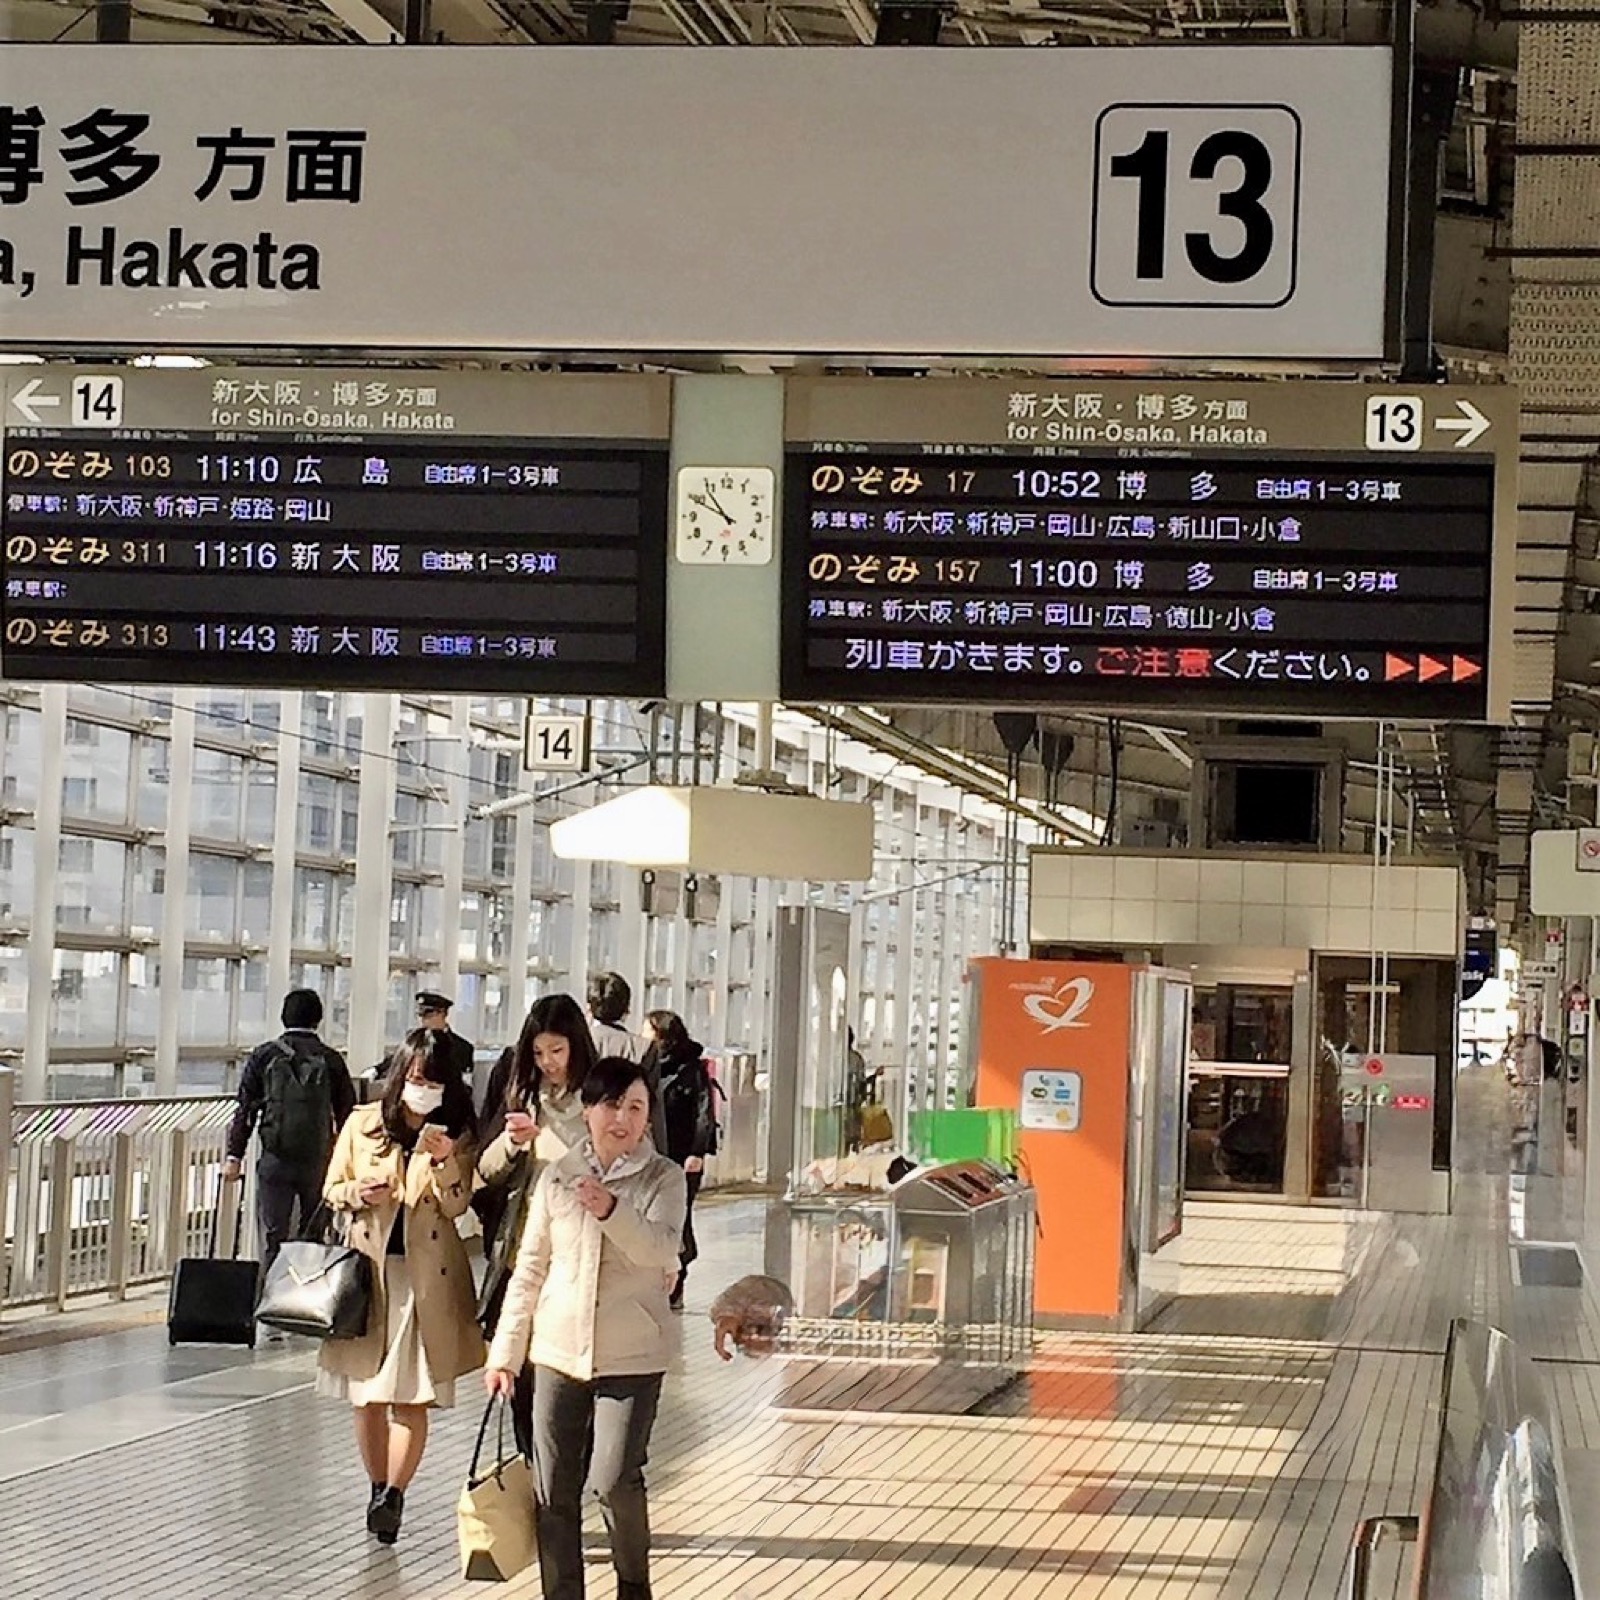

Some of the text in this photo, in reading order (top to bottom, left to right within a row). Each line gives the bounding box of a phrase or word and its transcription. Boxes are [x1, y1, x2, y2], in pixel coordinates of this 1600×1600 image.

[194, 127, 367, 204] 方面
[1110, 130, 1274, 284] 13
[66, 226, 320, 290] Hakata
[76, 380, 117, 421] 14
[211, 408, 241, 427] for
[382, 410, 455, 430] Hakata
[1007, 421, 1039, 440] for
[1189, 424, 1268, 444] Hakata
[1370, 402, 1416, 443] 13
[7, 449, 113, 479] のぞみ
[126, 455, 171, 477] 103
[196, 454, 279, 483] 11:10
[811, 465, 923, 495] のぞみ
[947, 470, 977, 493] 17
[1011, 469, 1101, 498] 10:52
[6, 535, 111, 565] のぞみ
[121, 541, 168, 564] 311
[194, 540, 278, 568] 11:16
[808, 553, 920, 584] のぞみ
[934, 559, 981, 583] 157
[1009, 558, 1099, 588] 11:00
[6, 617, 111, 646] のぞみ
[121, 624, 169, 647] 313
[194, 623, 277, 652] 11:43
[537, 726, 574, 761] 14
